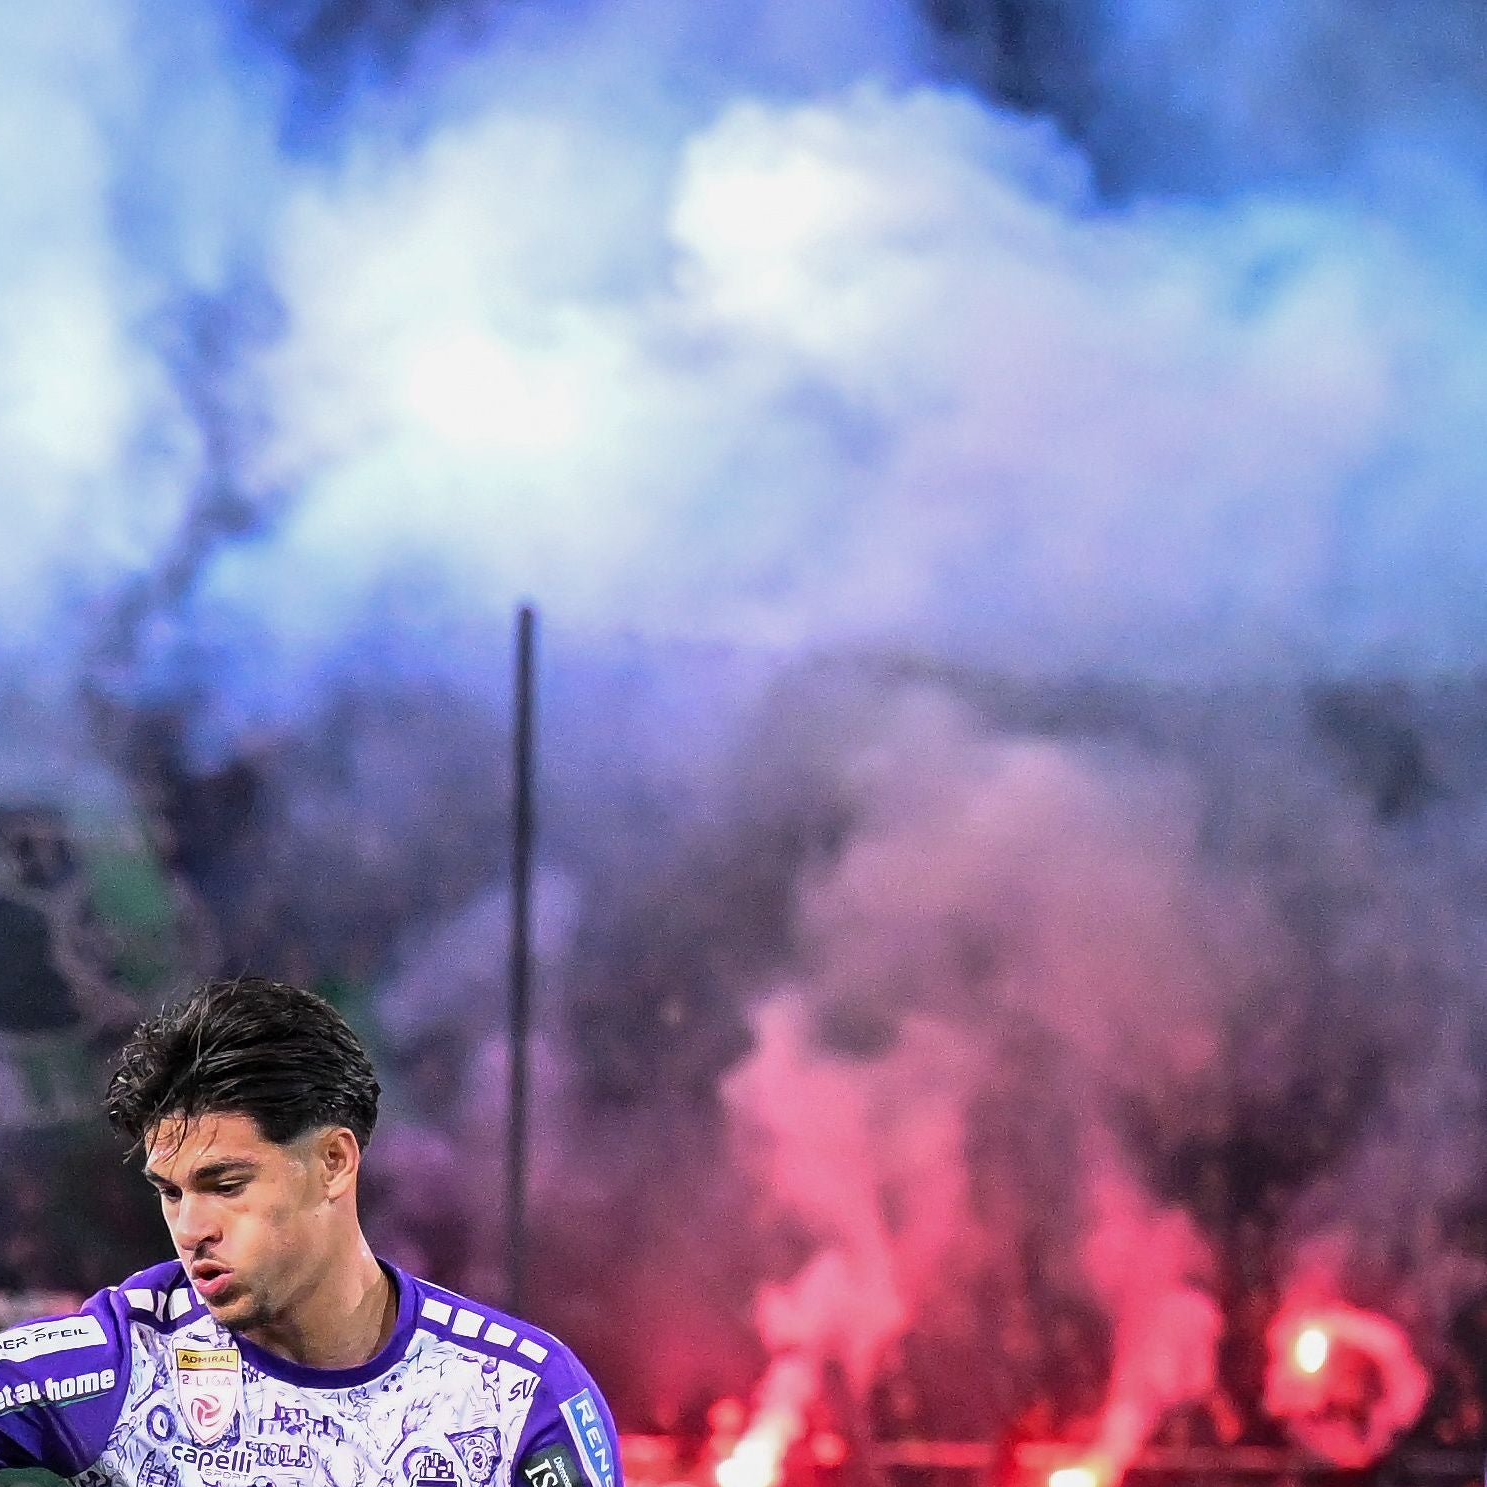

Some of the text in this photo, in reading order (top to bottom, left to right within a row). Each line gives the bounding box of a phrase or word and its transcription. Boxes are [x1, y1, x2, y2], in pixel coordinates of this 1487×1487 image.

[33, 1328, 90, 1343] PFEIL
[181, 1353, 234, 1364] ADMIRAL
[195, 1373, 233, 1388] LIGA
[171, 1444, 254, 1475] capelli
[203, 1467, 251, 1480] SPORT
